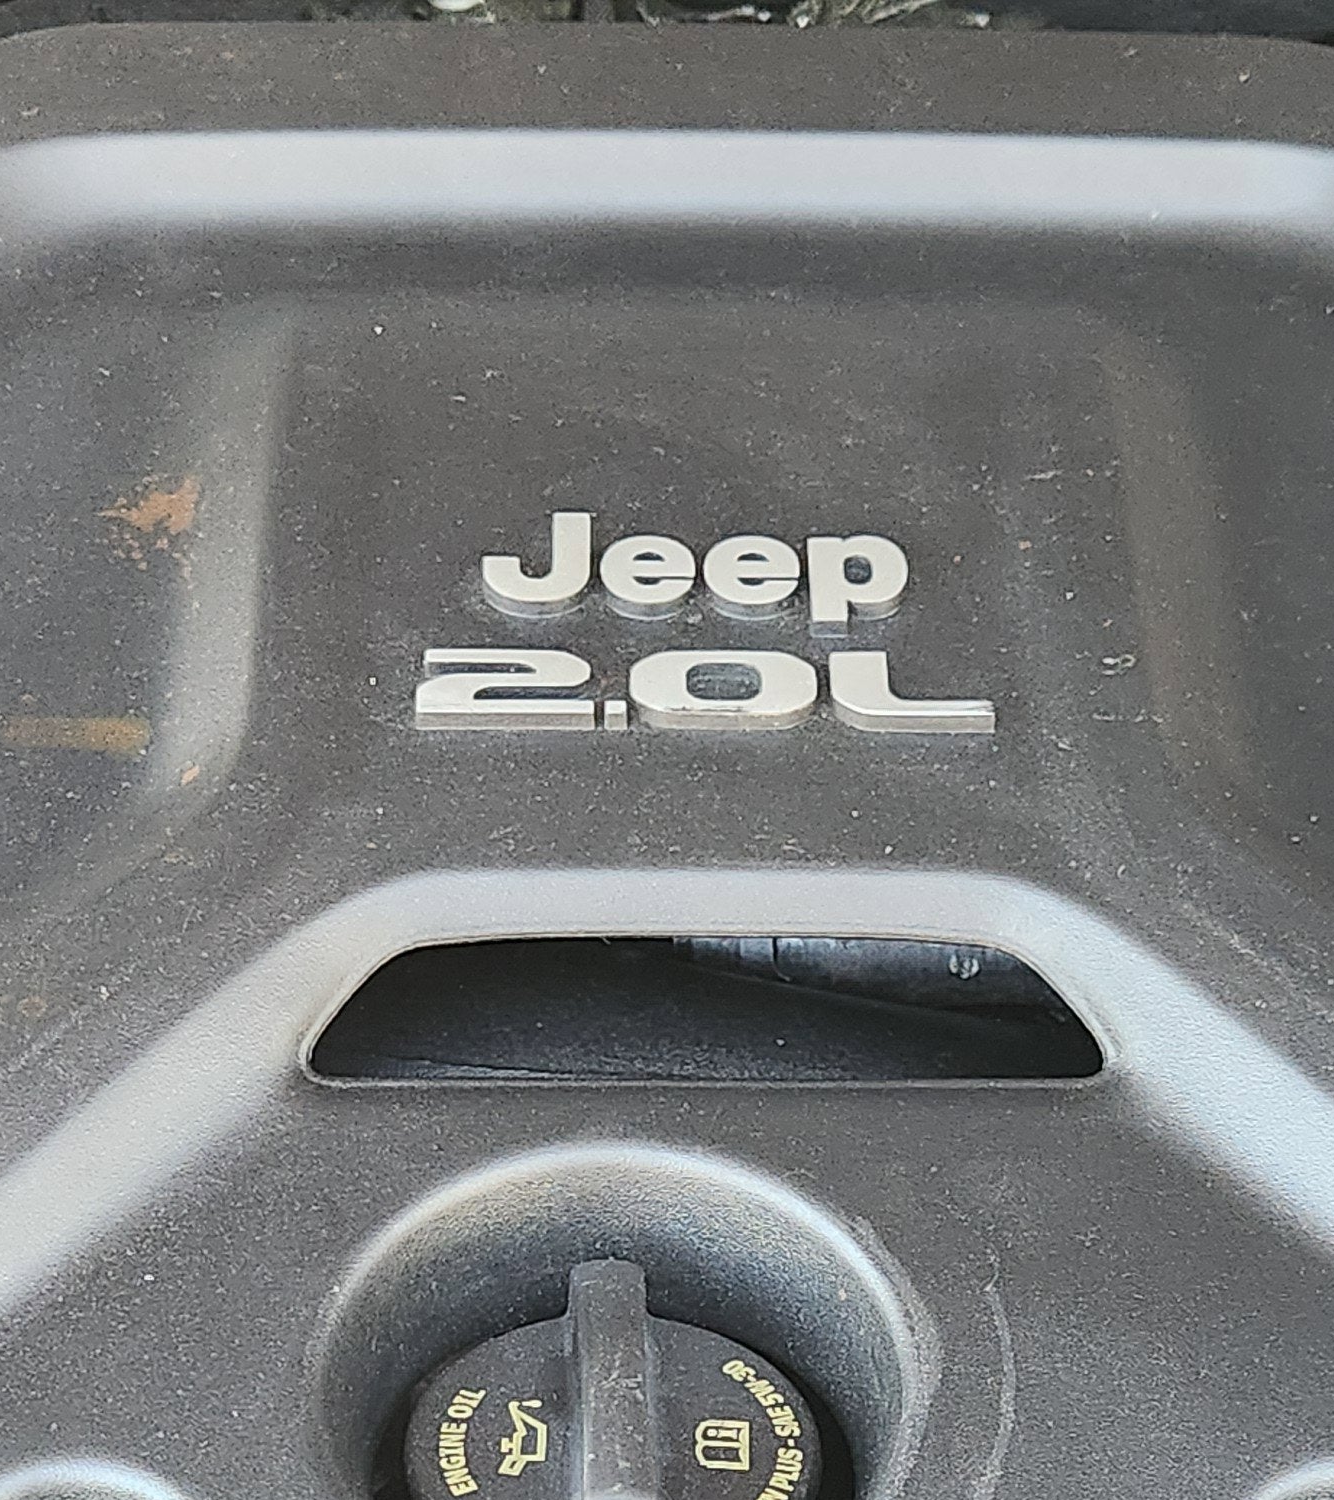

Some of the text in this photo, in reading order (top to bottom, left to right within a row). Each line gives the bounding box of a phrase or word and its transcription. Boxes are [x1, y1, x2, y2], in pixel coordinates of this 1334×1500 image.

[482, 511, 909, 637] Jeep
[415, 648, 996, 734] 2.0L
[722, 1359, 784, 1406] 5W-30
[439, 1389, 487, 1497] ENGINE OIL
[769, 1447, 804, 1492] PLUS
